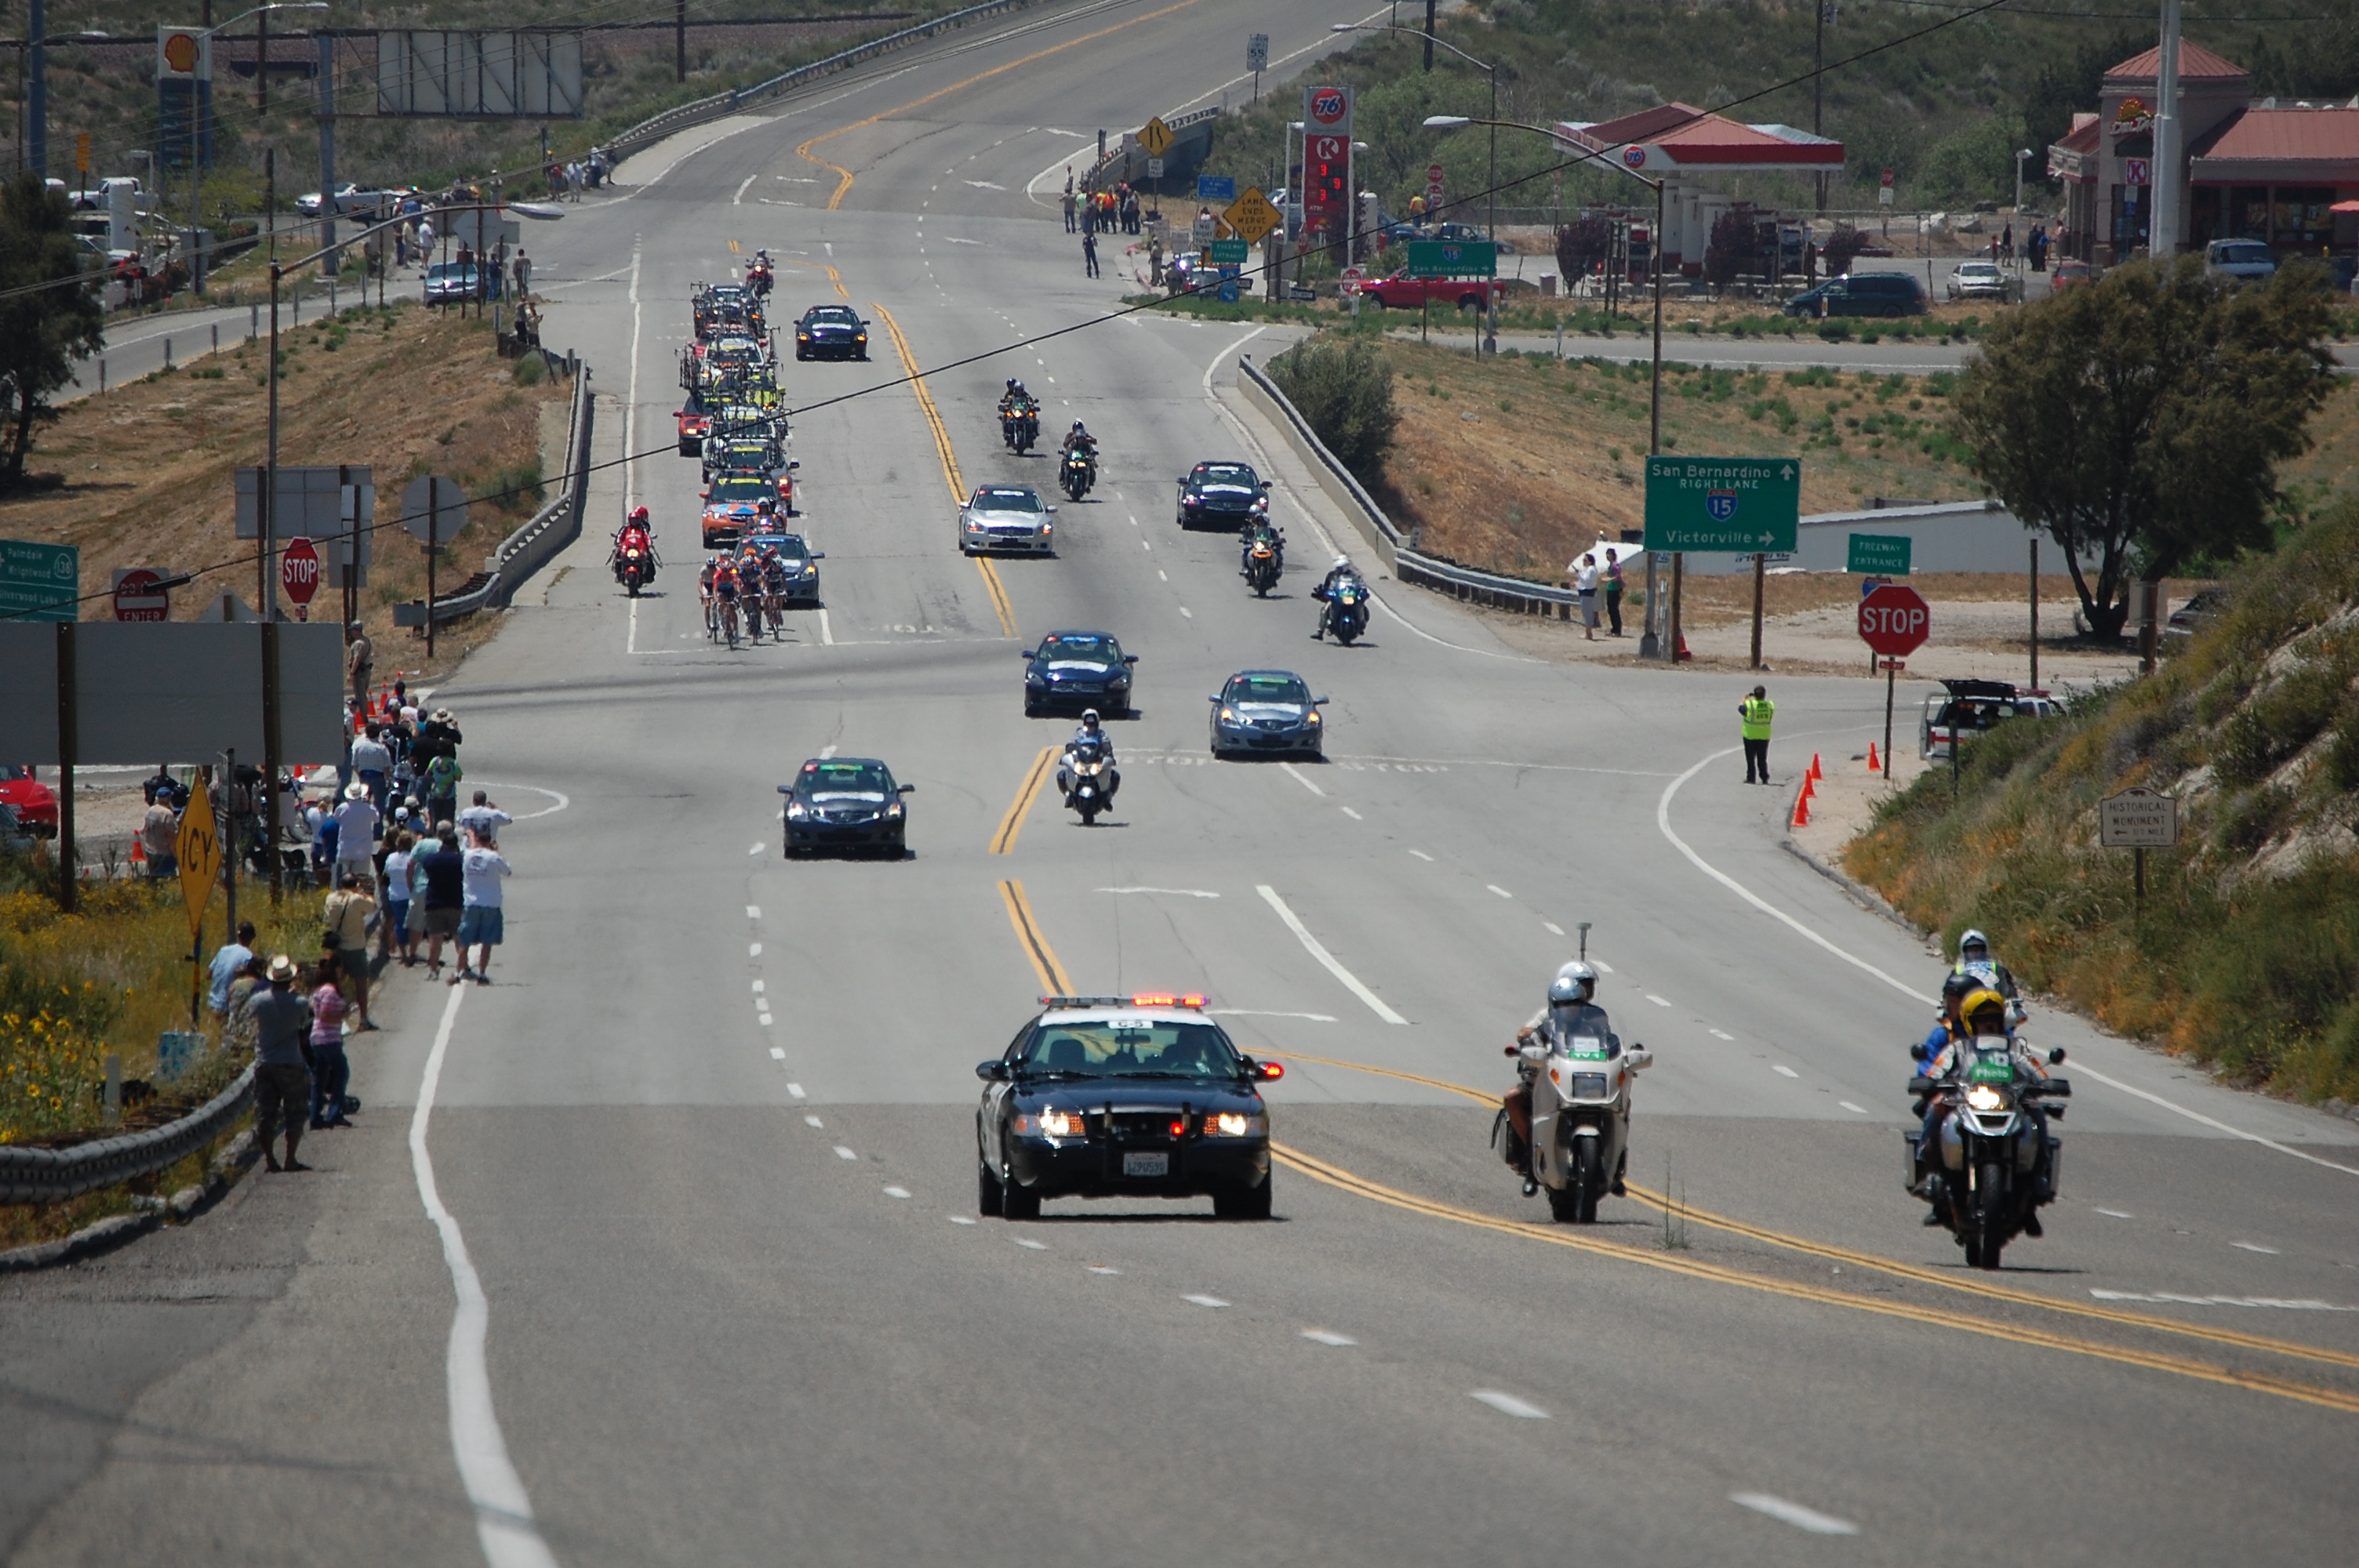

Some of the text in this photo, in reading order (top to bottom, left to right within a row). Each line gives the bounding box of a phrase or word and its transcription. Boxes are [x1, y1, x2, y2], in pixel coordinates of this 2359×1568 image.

[1250, 48, 1264, 59] 55
[1316, 95, 1341, 116] 76
[2135, 116, 2155, 132] TAC
[1319, 140, 1337, 158] K
[1627, 151, 1643, 163] 76
[2128, 162, 2144, 183] K
[1652, 464, 1771, 478] San Bernardino
[1680, 479, 1759, 489] RIGHT LANE
[1714, 499, 1732, 515] 15
[1667, 530, 1752, 543] Victorville
[7, 547, 42, 560] Palmdale
[1859, 542, 1902, 552] FREEWAY
[56, 561, 71, 575] 138
[1855, 557, 1903, 568] ENTRANCE
[8, 564, 51, 579] Wrightwood
[285, 558, 317, 583] STOP
[0, 589, 37, 602] ilverwood
[124, 611, 160, 622] ENTER
[1863, 607, 1925, 634] STOP
[2109, 802, 2168, 812] HISTORICAL
[2113, 815, 2165, 826] MONUMENT
[182, 825, 213, 876] ICY
[1976, 1068, 2009, 1078] Photo
